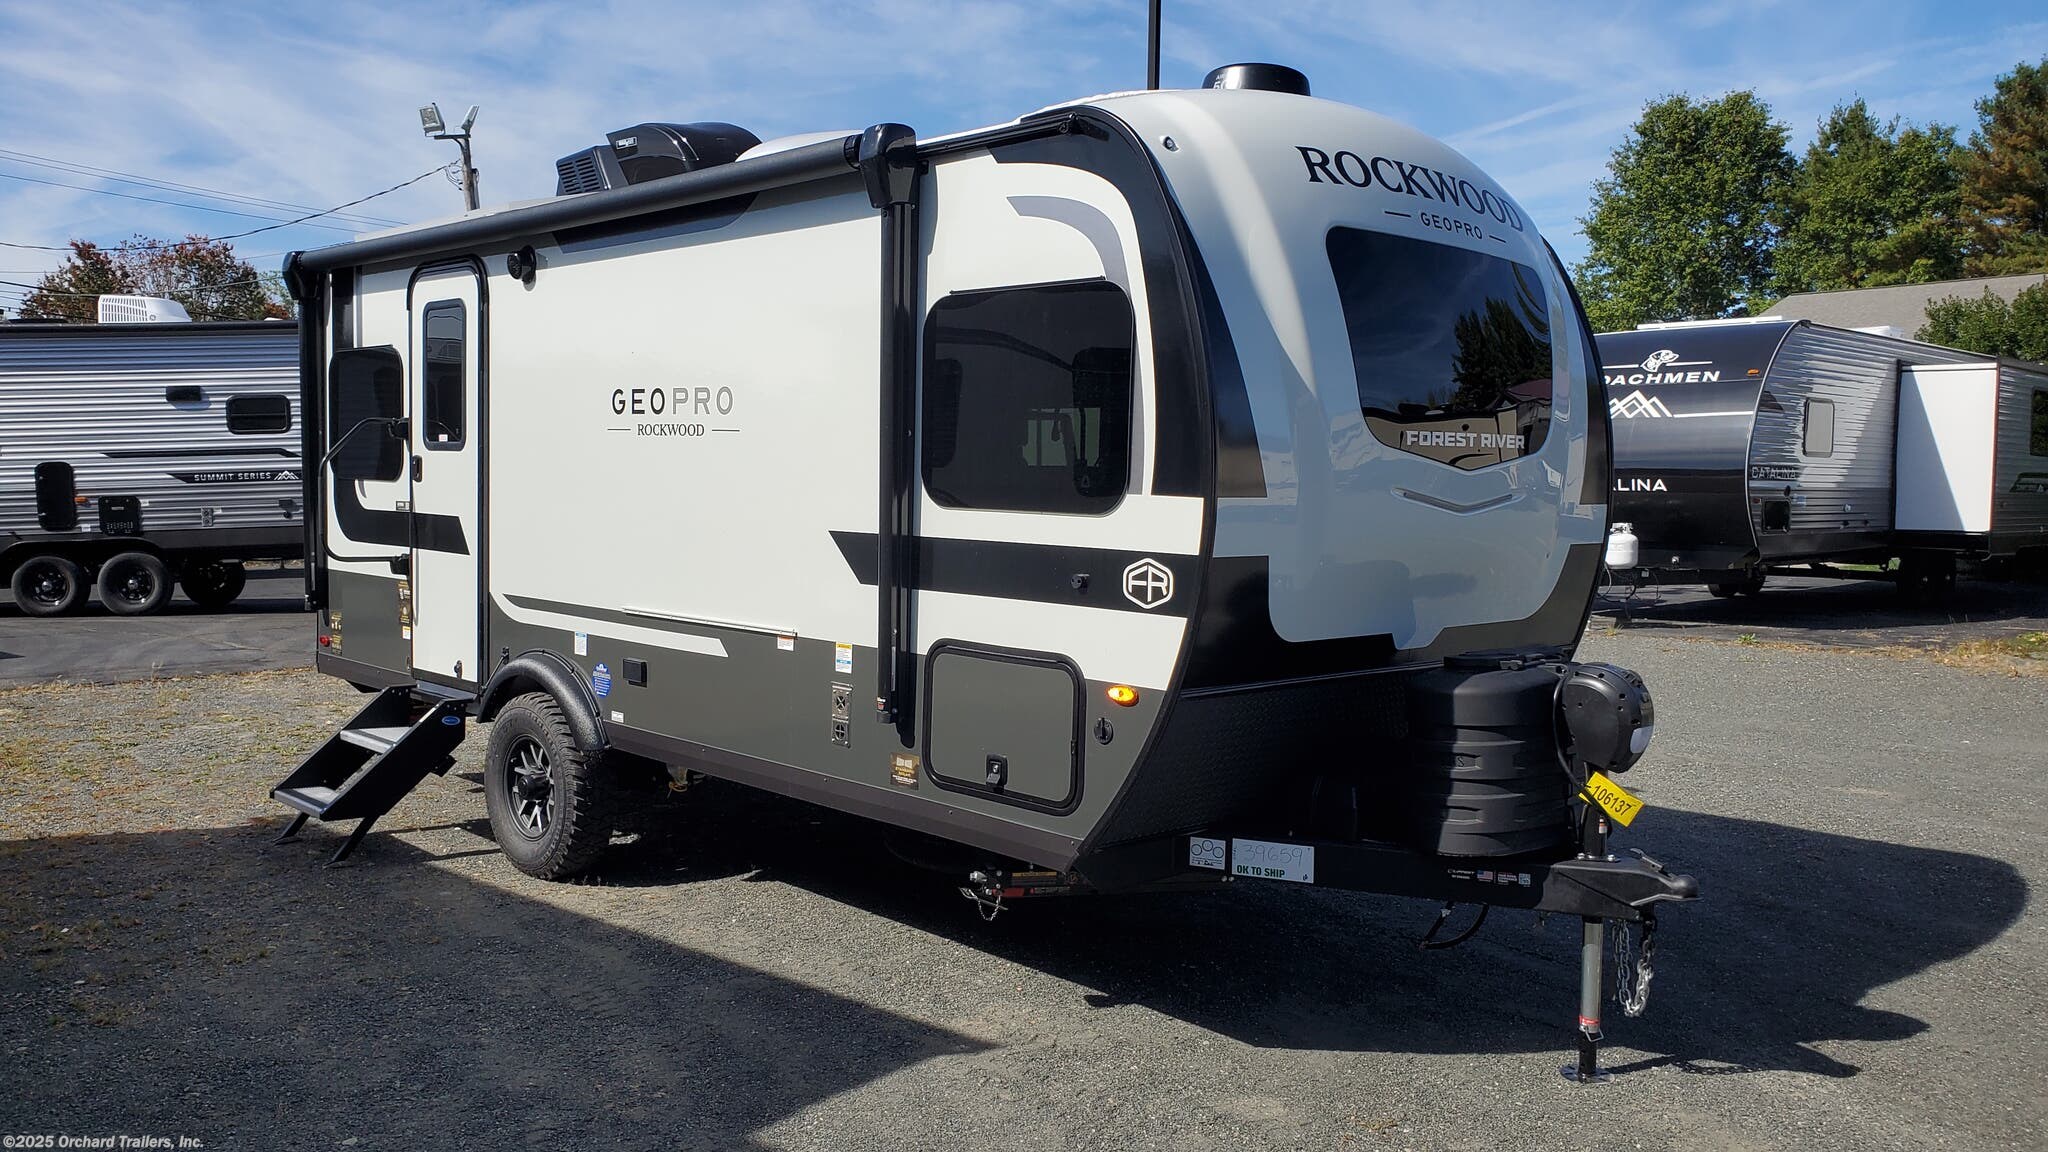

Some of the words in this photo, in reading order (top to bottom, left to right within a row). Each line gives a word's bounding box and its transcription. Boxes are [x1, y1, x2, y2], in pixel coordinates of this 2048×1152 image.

[1295, 146, 1523, 232] ROCKWOOD
[1420, 211, 1483, 240] GEOPRO
[1604, 370, 1721, 386] ACHMEN
[612, 386, 733, 415] GEOPRO
[637, 423, 705, 437] ROCKWOOD
[1406, 430, 1478, 448] FOREST
[1480, 433, 1525, 450] RIVER
[194, 473, 234, 481] SUMMIT
[238, 472, 271, 480] SERIES
[1613, 478, 1668, 492] LINA
[1592, 785, 1632, 816] 106137
[1237, 864, 1249, 875] OK
[1250, 866, 1263, 876] TO
[1264, 867, 1285, 878] SHIP
